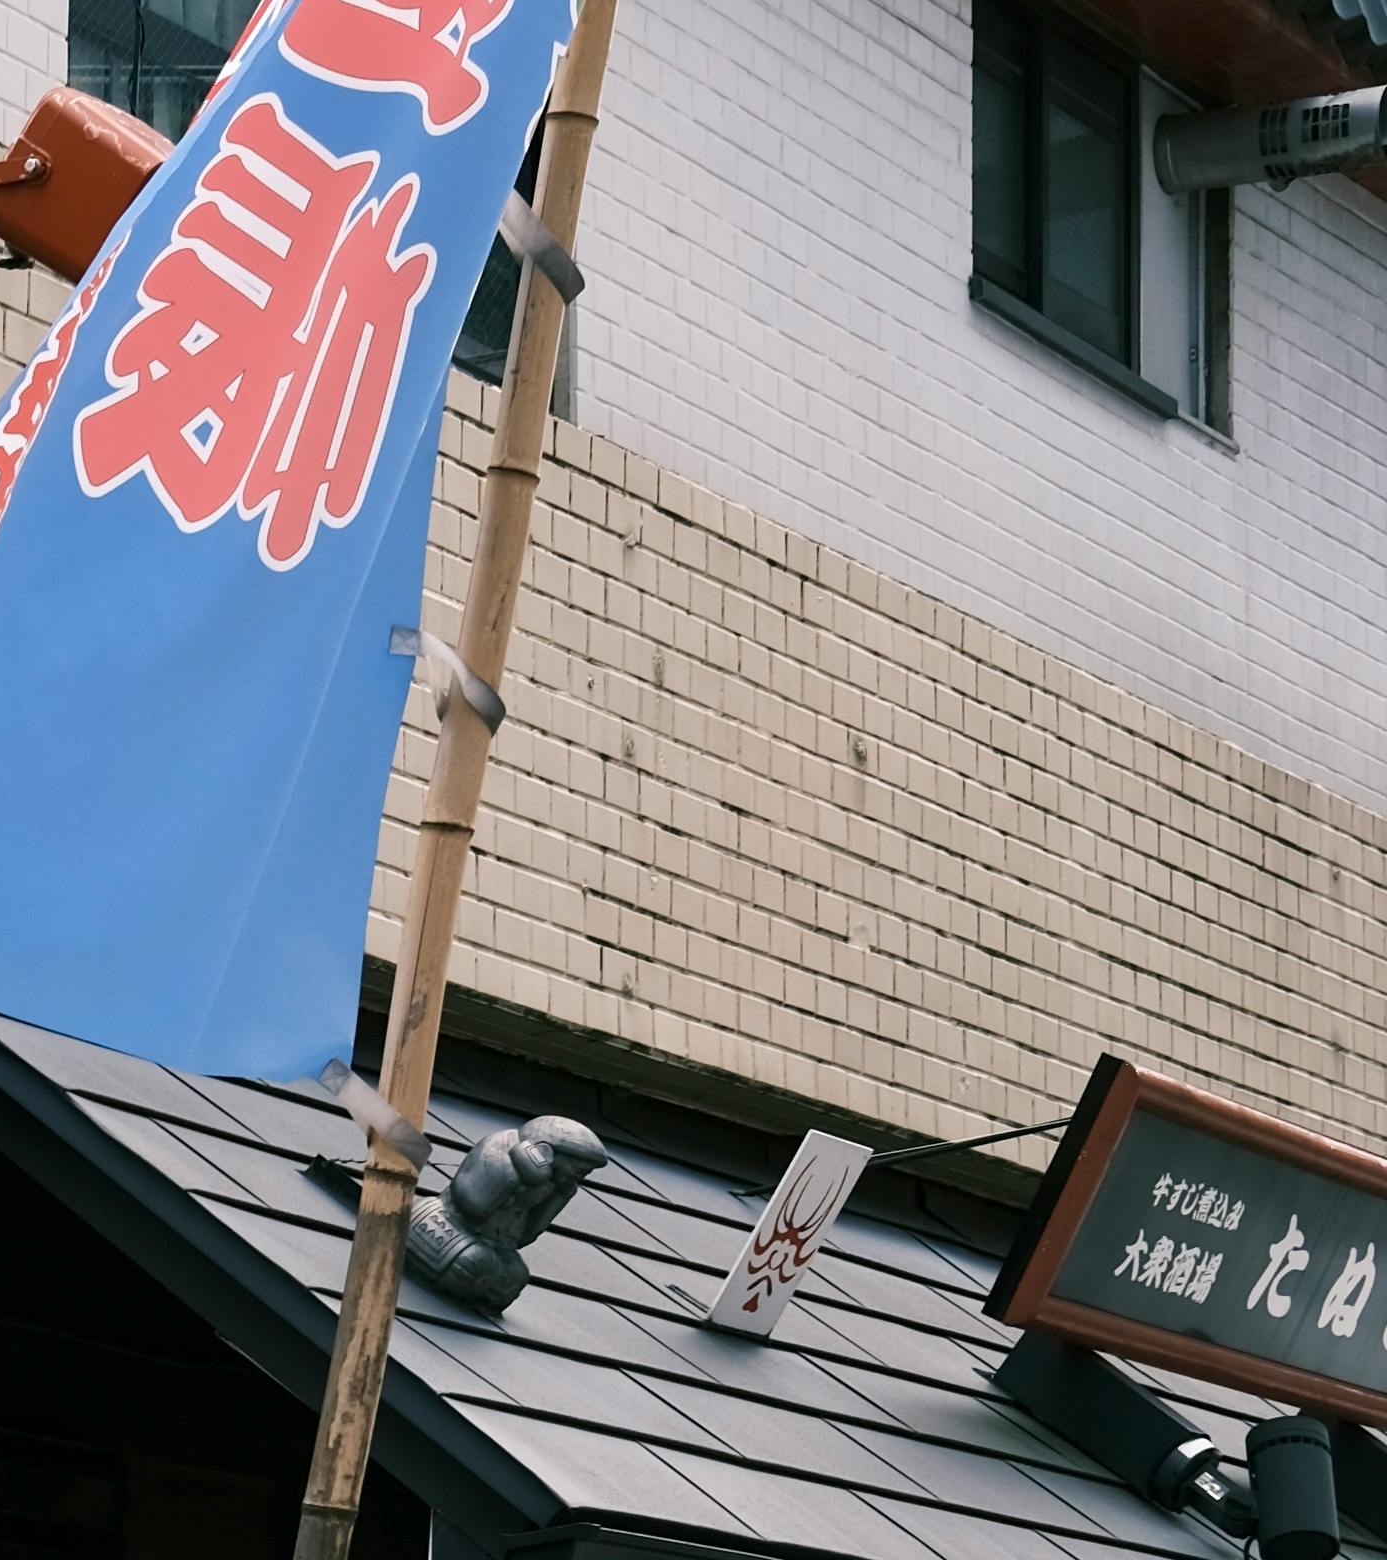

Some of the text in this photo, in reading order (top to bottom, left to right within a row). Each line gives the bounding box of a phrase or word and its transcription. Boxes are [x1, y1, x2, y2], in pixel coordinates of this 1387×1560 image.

[1152, 1172, 1246, 1231] 牛すじ煮込み
[1114, 1228, 1224, 1305] 大衆酒場
[1246, 1214, 1387, 1352] たぬ
